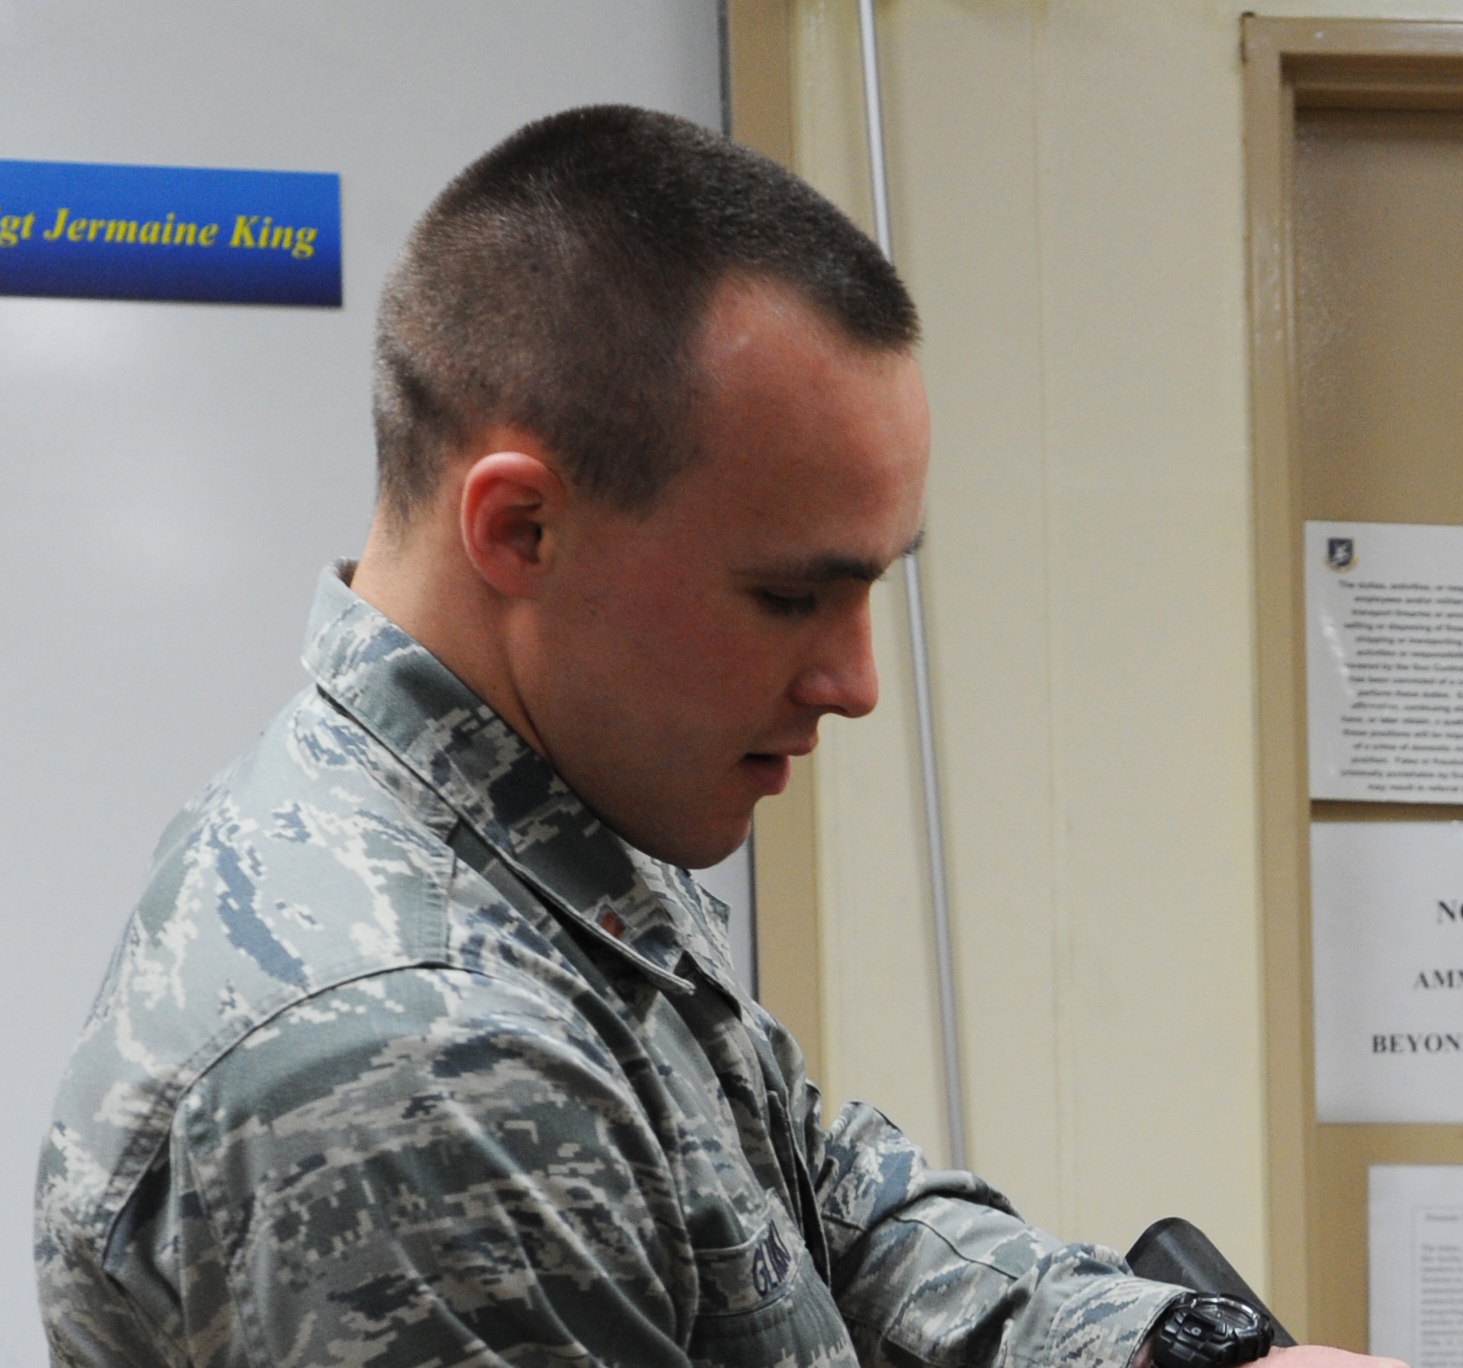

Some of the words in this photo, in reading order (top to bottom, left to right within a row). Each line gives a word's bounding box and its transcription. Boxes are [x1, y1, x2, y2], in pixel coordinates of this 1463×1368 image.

[0, 208, 36, 249] gt
[43, 207, 220, 247] Jermaine
[229, 214, 319, 260] King
